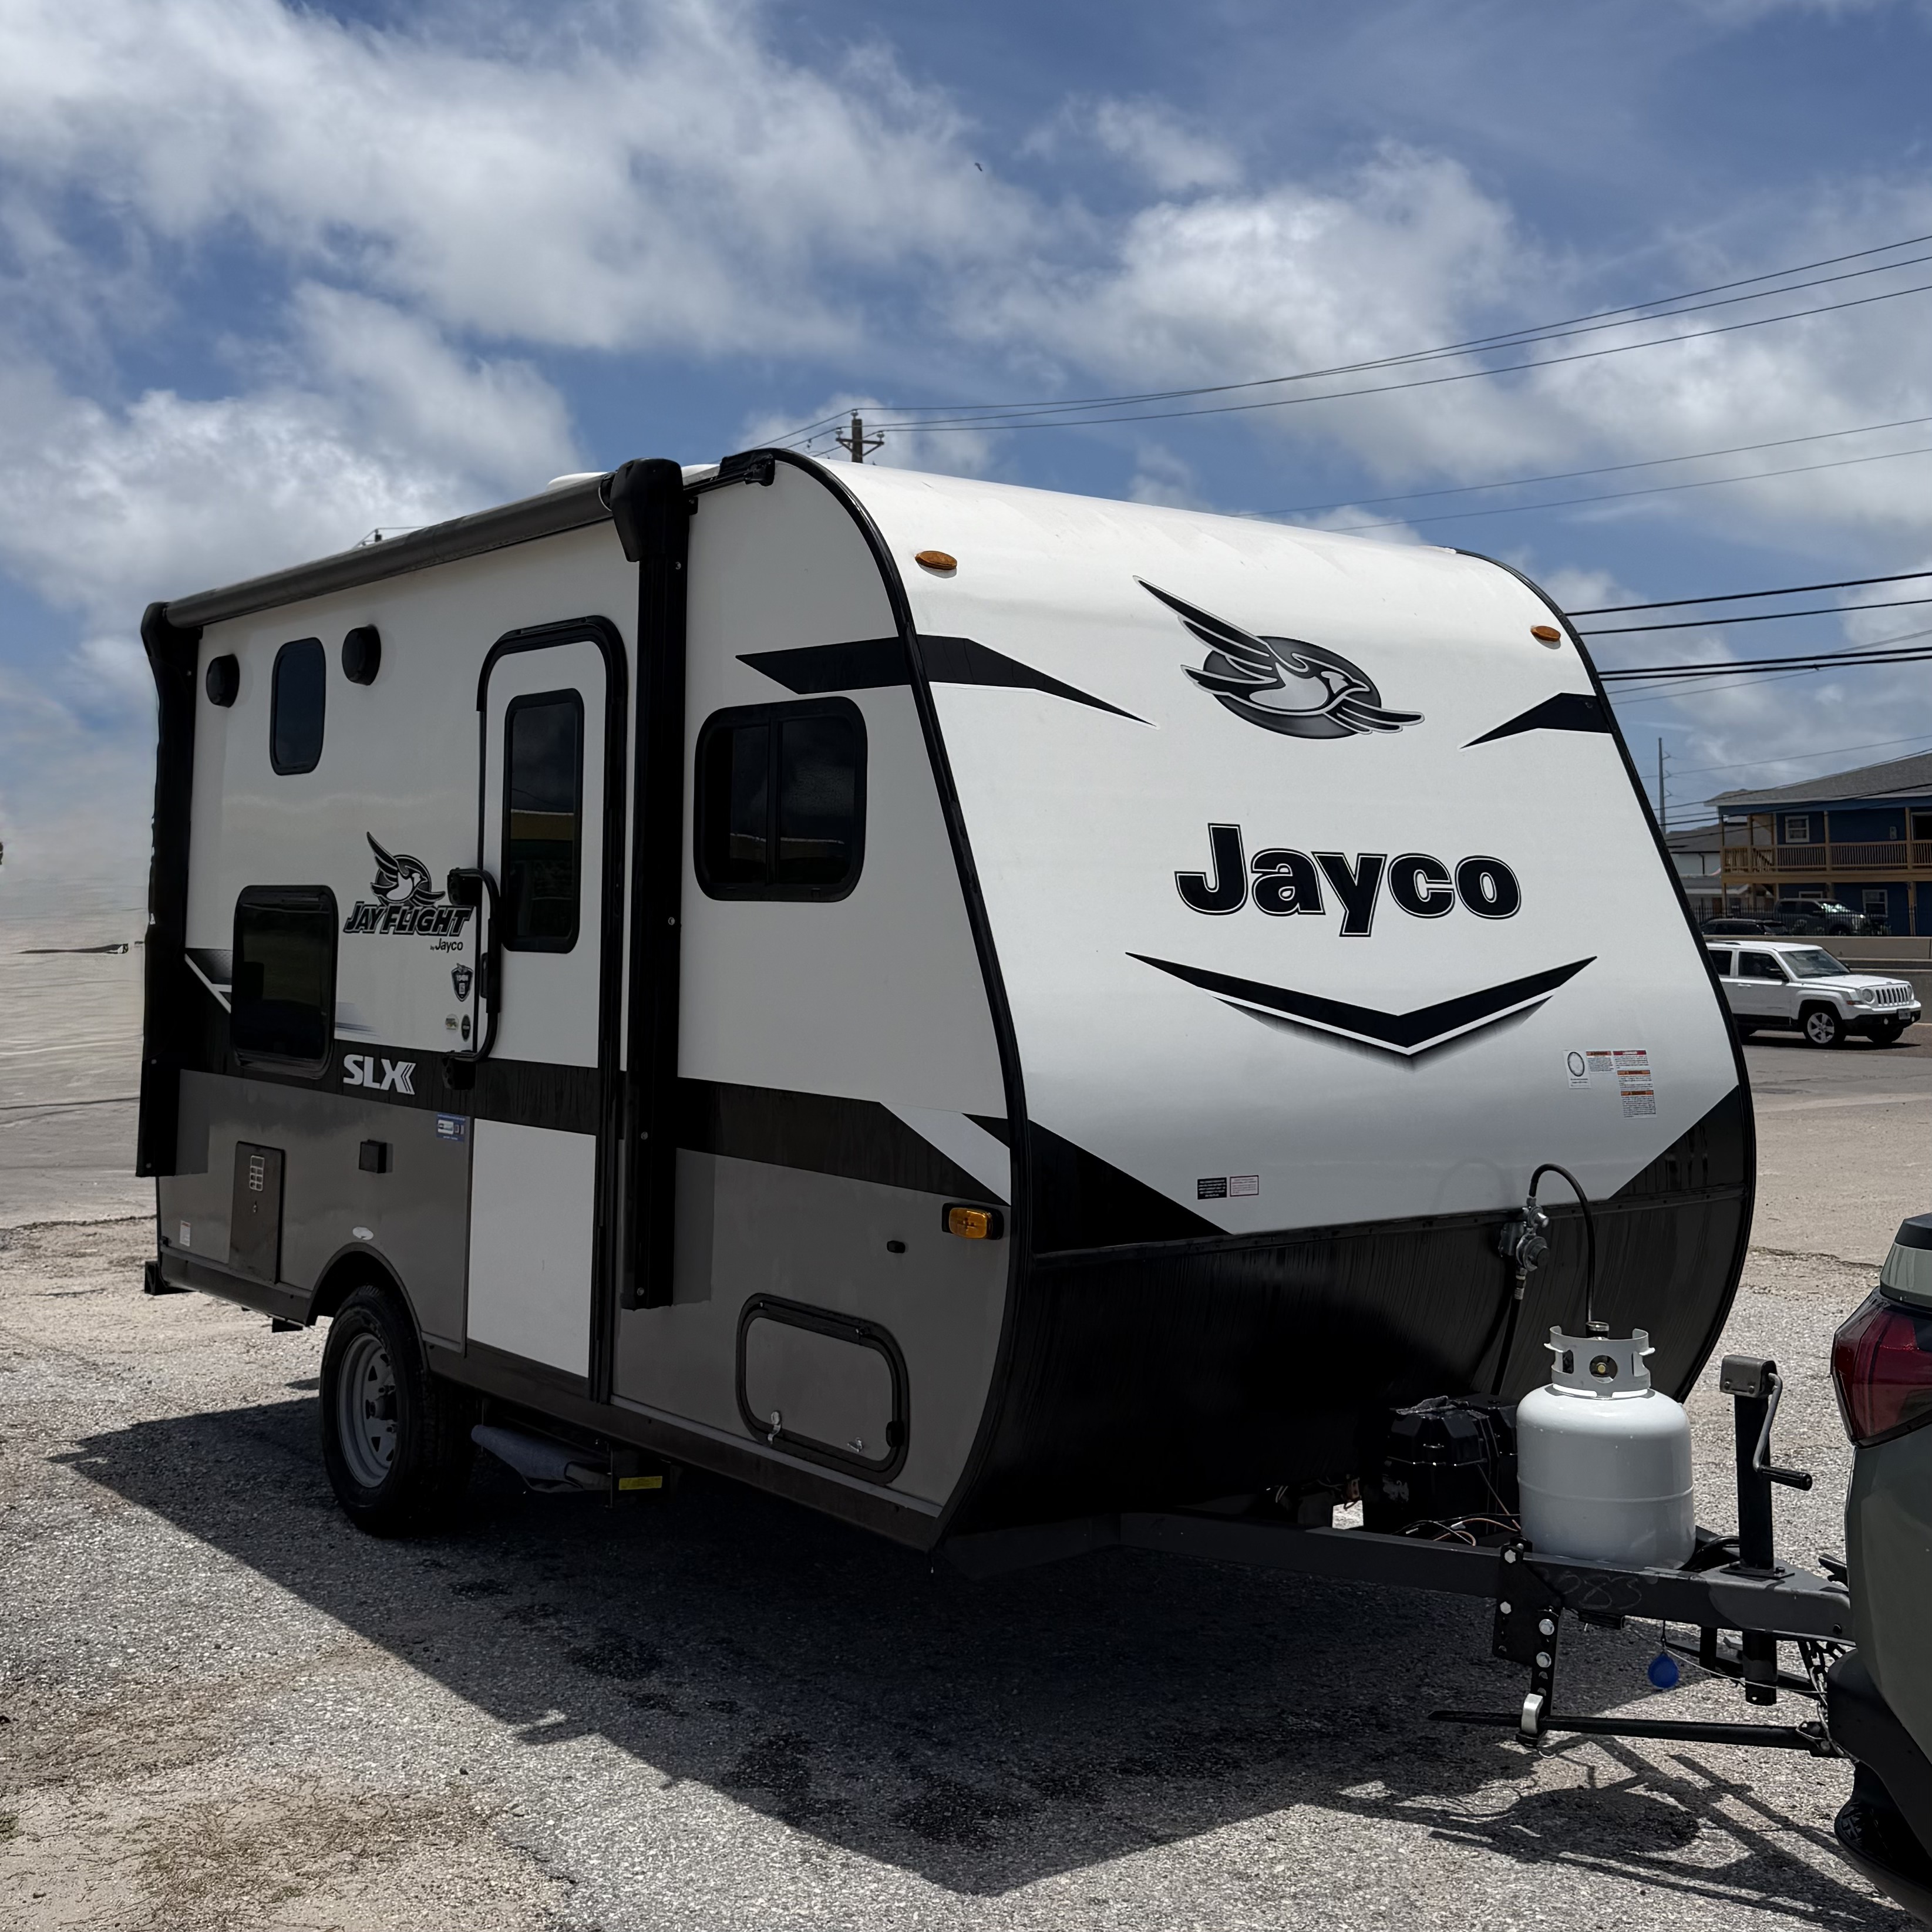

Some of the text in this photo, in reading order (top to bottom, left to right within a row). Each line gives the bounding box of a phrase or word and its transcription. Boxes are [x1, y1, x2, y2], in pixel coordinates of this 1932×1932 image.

[1174, 822, 1522, 937] Jayco
[343, 901, 474, 937] JAY FLIGHT
[435, 938, 463, 952] Jayco
[343, 1053, 416, 1095] SLX
